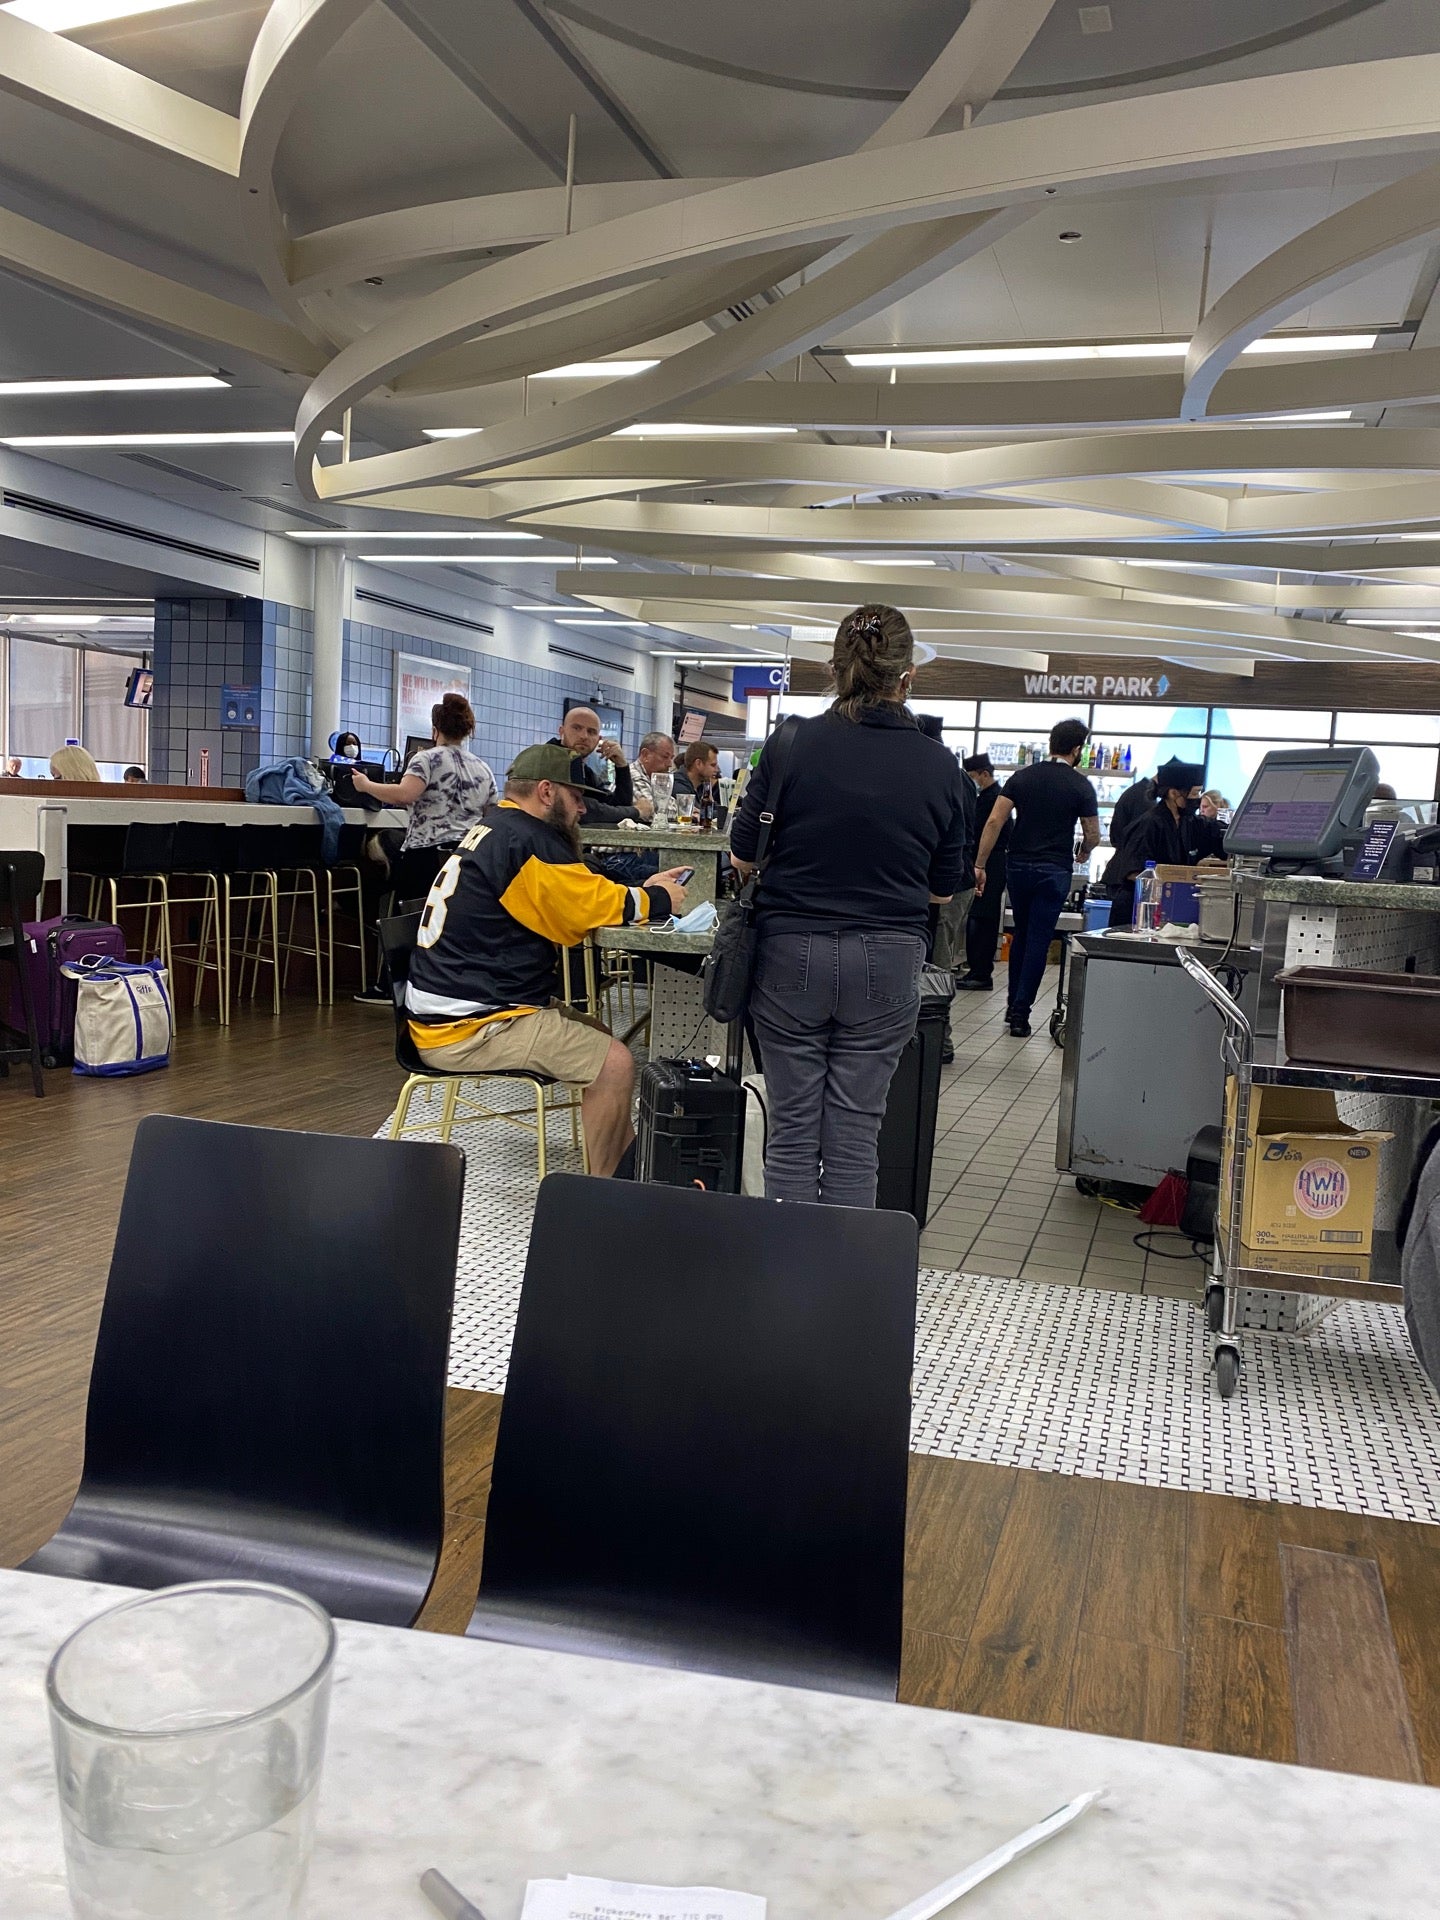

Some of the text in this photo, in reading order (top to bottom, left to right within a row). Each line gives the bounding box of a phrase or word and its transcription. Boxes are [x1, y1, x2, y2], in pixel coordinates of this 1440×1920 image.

[1024, 674, 1153, 697] WICKER PARK
[1350, 1148, 1368, 1156] NEW
[1298, 1168, 1345, 1197] AWA
